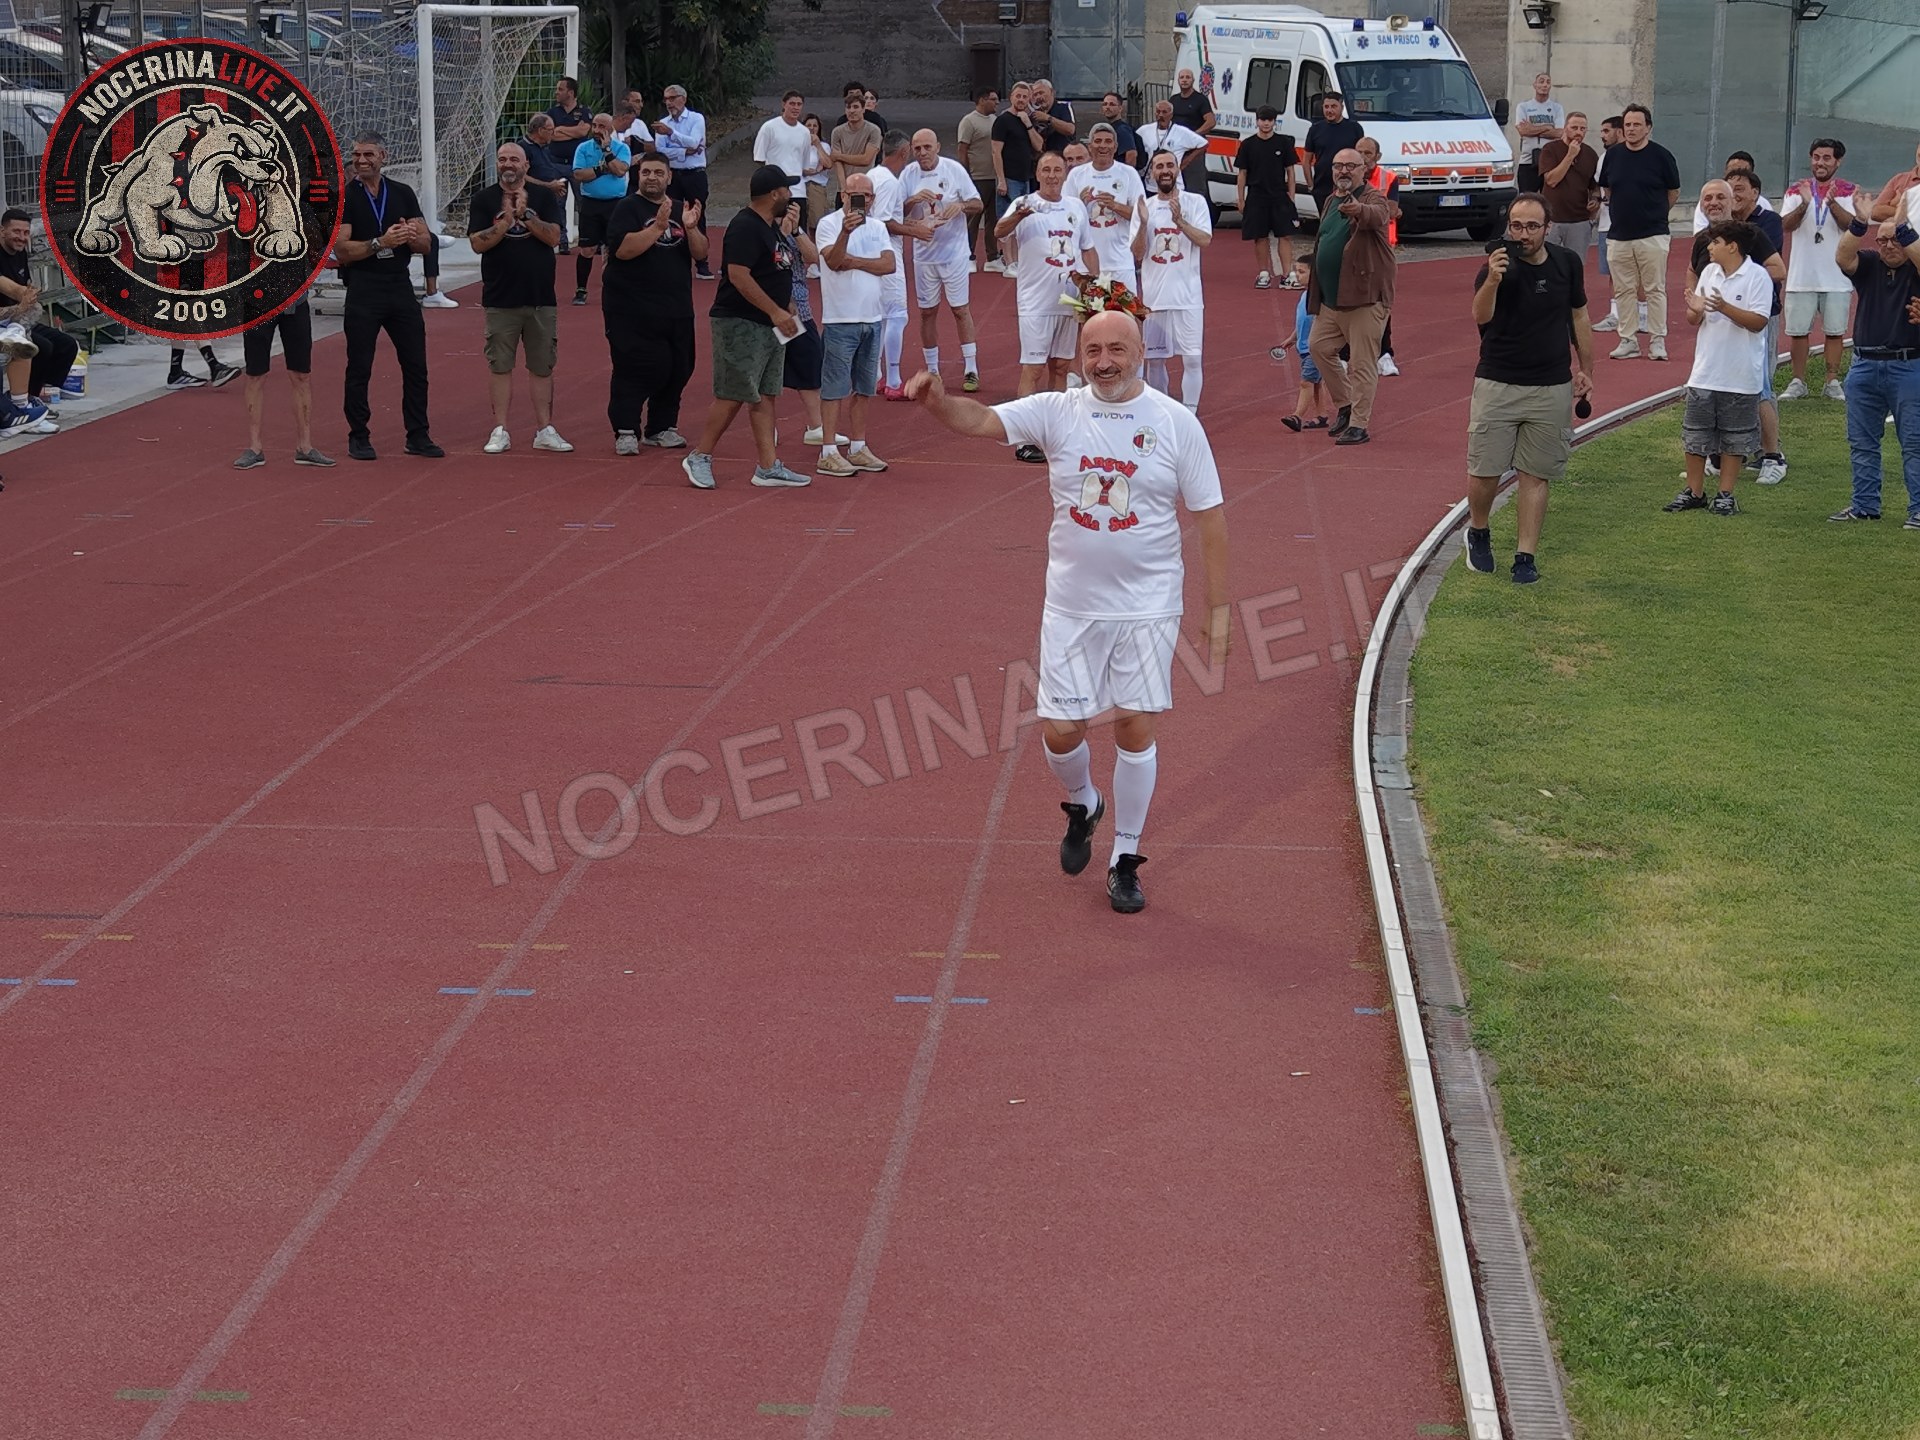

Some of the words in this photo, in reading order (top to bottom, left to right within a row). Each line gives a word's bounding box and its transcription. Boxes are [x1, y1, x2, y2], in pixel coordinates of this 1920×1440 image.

[1377, 34, 1392, 45] SAN
[1393, 34, 1420, 45] PRISCO
[1091, 411, 1134, 420] GIVOVA
[1079, 455, 1138, 478] Angeli
[1069, 505, 1100, 531] della
[1108, 511, 1139, 532] Sud
